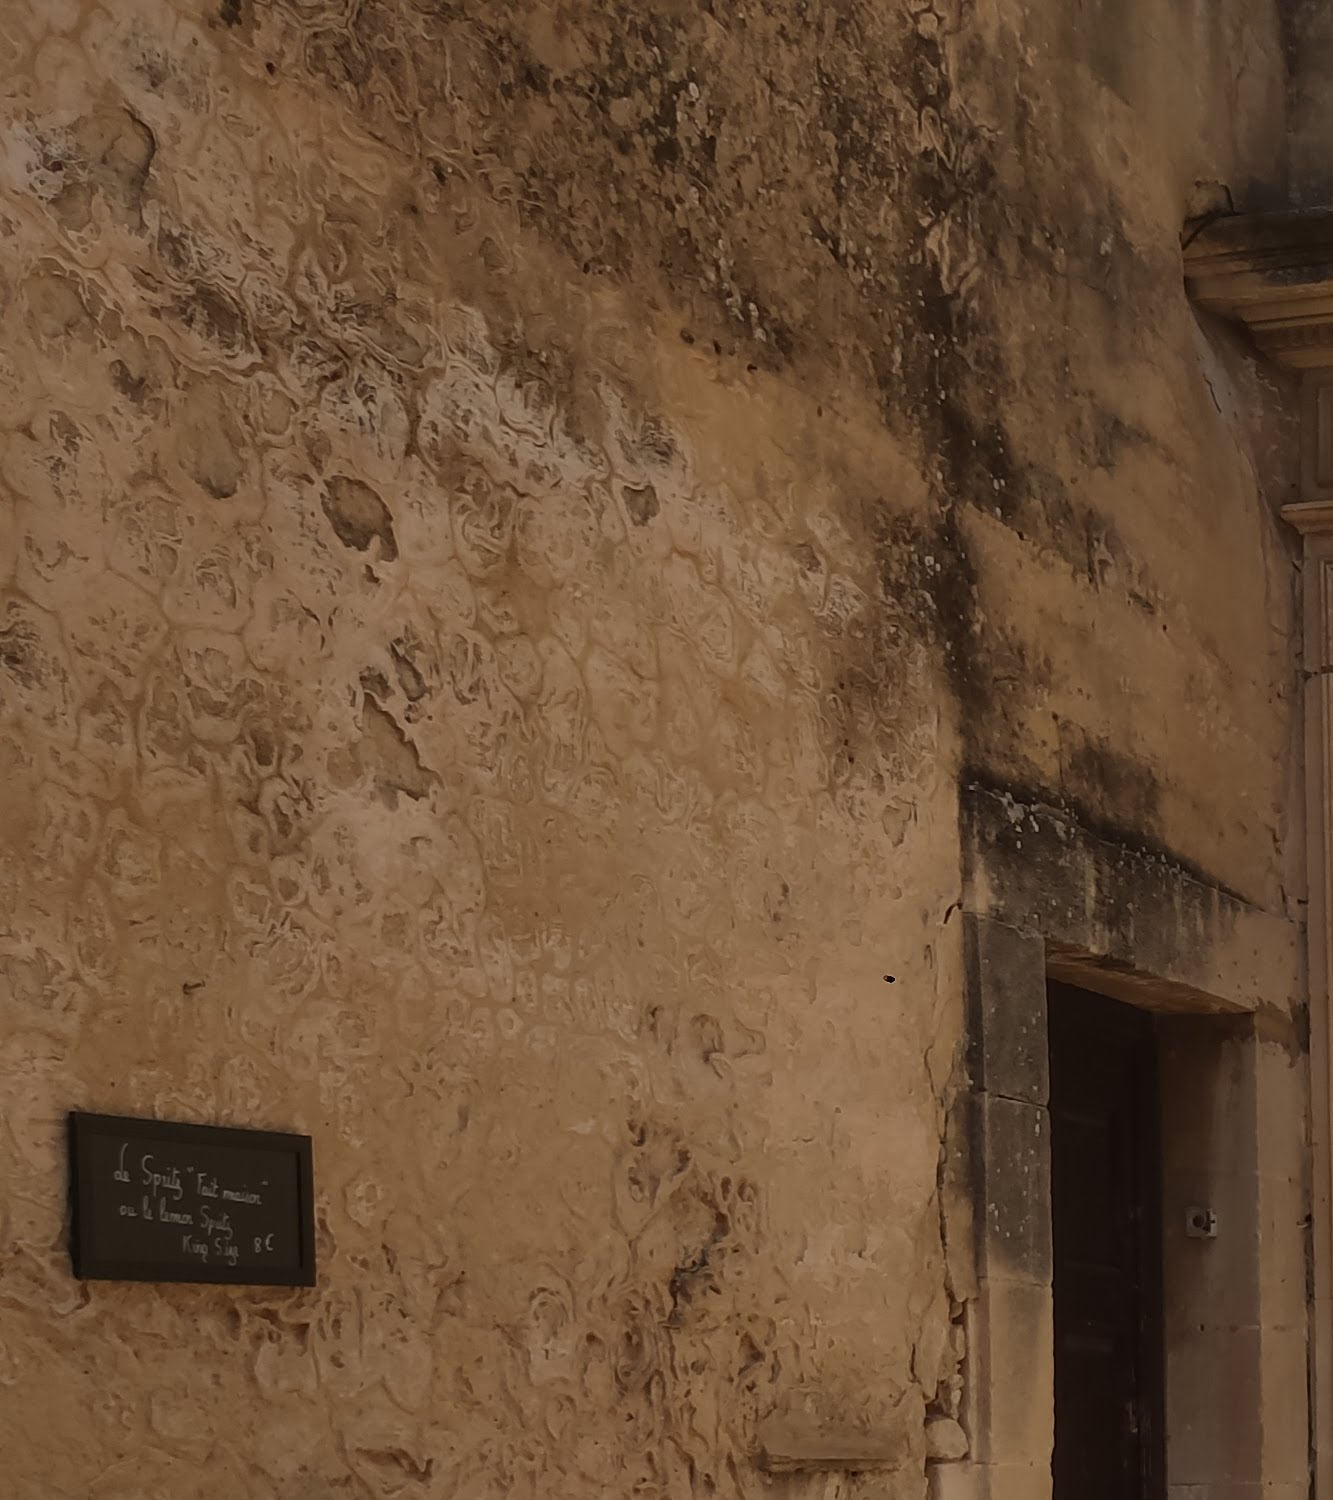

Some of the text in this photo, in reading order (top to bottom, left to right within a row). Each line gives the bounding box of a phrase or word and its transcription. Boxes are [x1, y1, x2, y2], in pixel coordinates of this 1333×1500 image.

[142, 1155, 183, 1201] Spritz
[120, 1195, 233, 1240] ou le lemon Spritz
[182, 1235, 208, 1263] King
